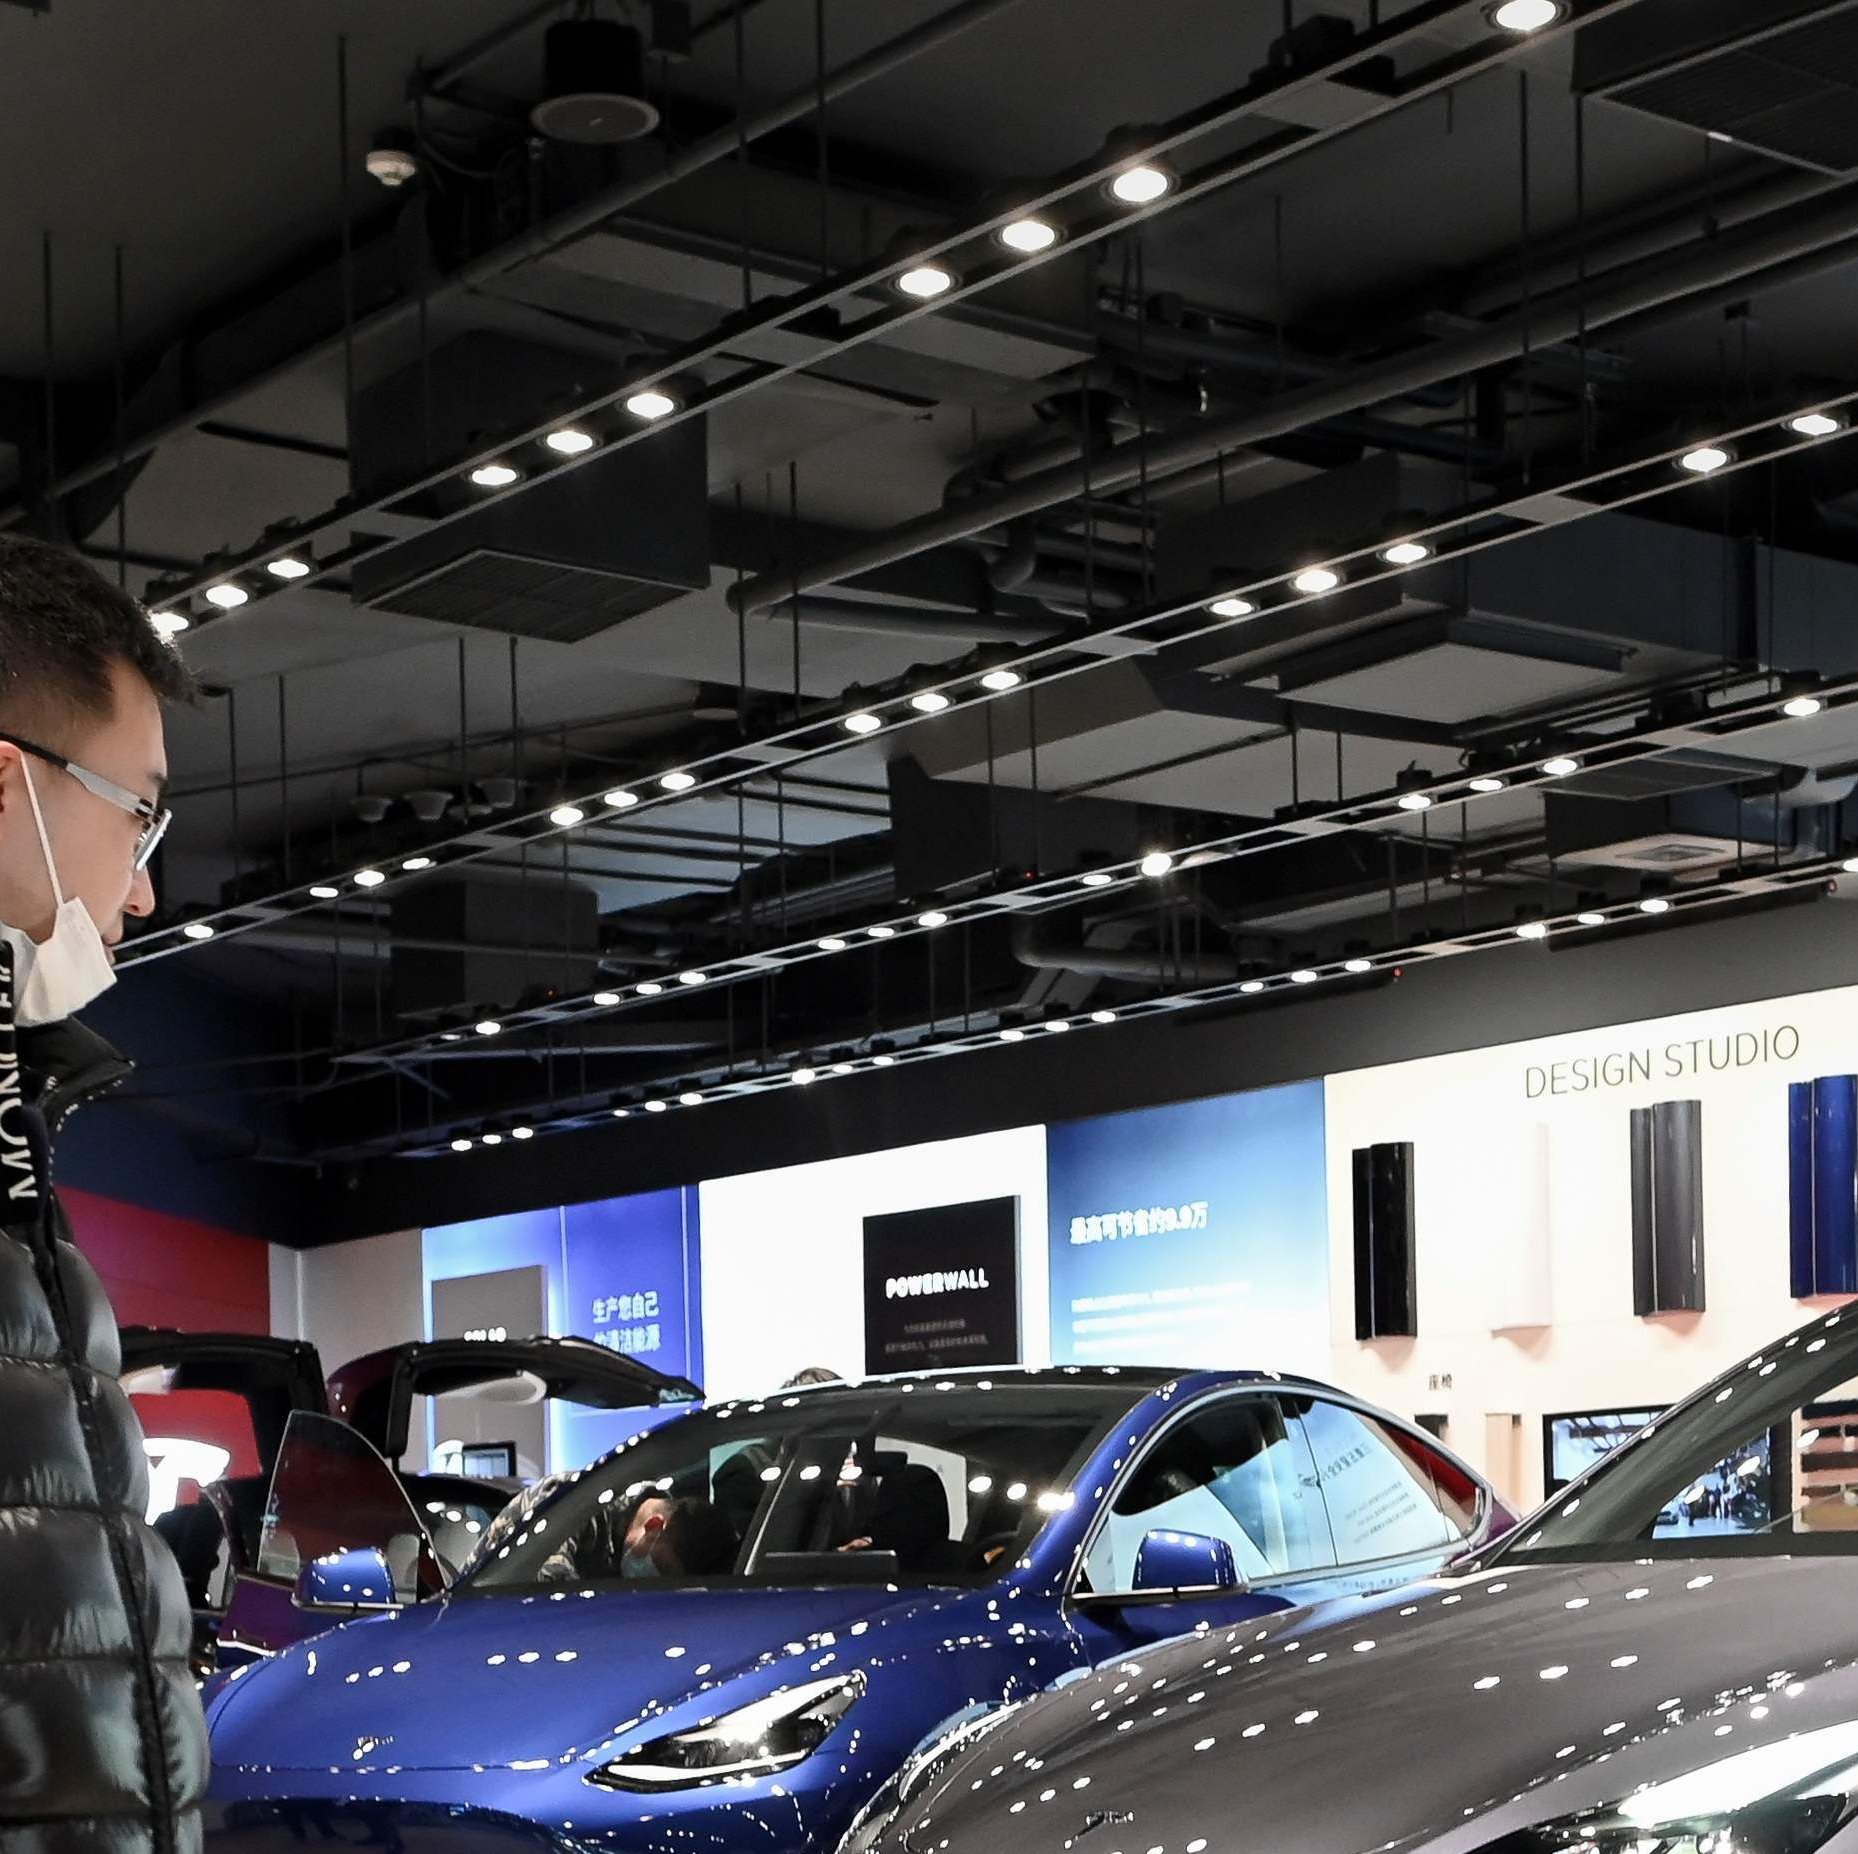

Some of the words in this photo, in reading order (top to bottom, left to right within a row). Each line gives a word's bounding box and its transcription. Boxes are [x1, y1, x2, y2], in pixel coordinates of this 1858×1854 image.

[1525, 1048, 1650, 1099] DESIGN
[1664, 1024, 1799, 1077] STUDIO
[885, 1267, 990, 1300] POWERWALL
